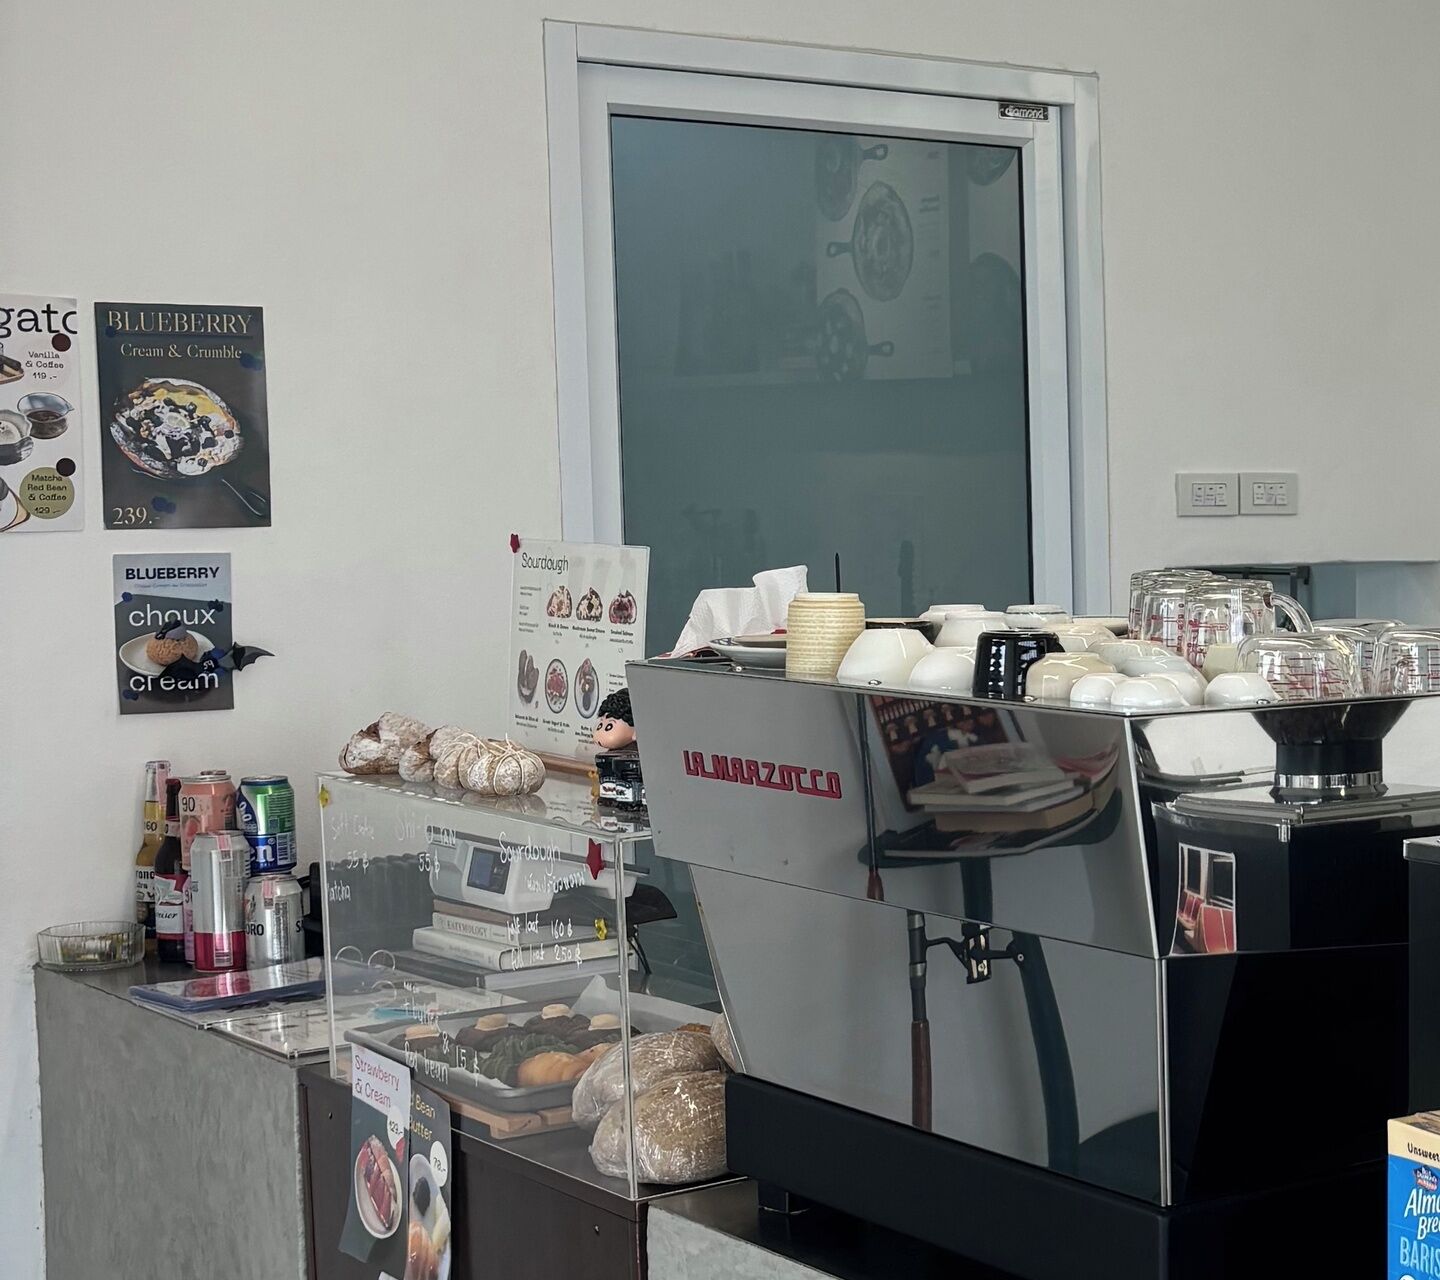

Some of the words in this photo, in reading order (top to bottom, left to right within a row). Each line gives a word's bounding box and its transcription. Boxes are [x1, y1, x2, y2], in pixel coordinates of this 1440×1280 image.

[108, 310, 252, 334] BLUEBERRY
[121, 344, 164, 358] Cream
[169, 345, 182, 358] &
[187, 344, 242, 360] Crumble
[36, 360, 64, 368] Coffee
[125, 567, 220, 580] BLUEBERRY
[522, 552, 568, 574] Sourdough
[711, 754, 842, 800] MARZOCCO
[182, 797, 196, 812] 90
[418, 853, 432, 872] 55
[499, 831, 561, 876] Sourdough
[554, 944, 572, 961] 250
[354, 1055, 400, 1091] Strawberry
[365, 1082, 391, 1107] Cream
[415, 1094, 437, 1119] Bean
